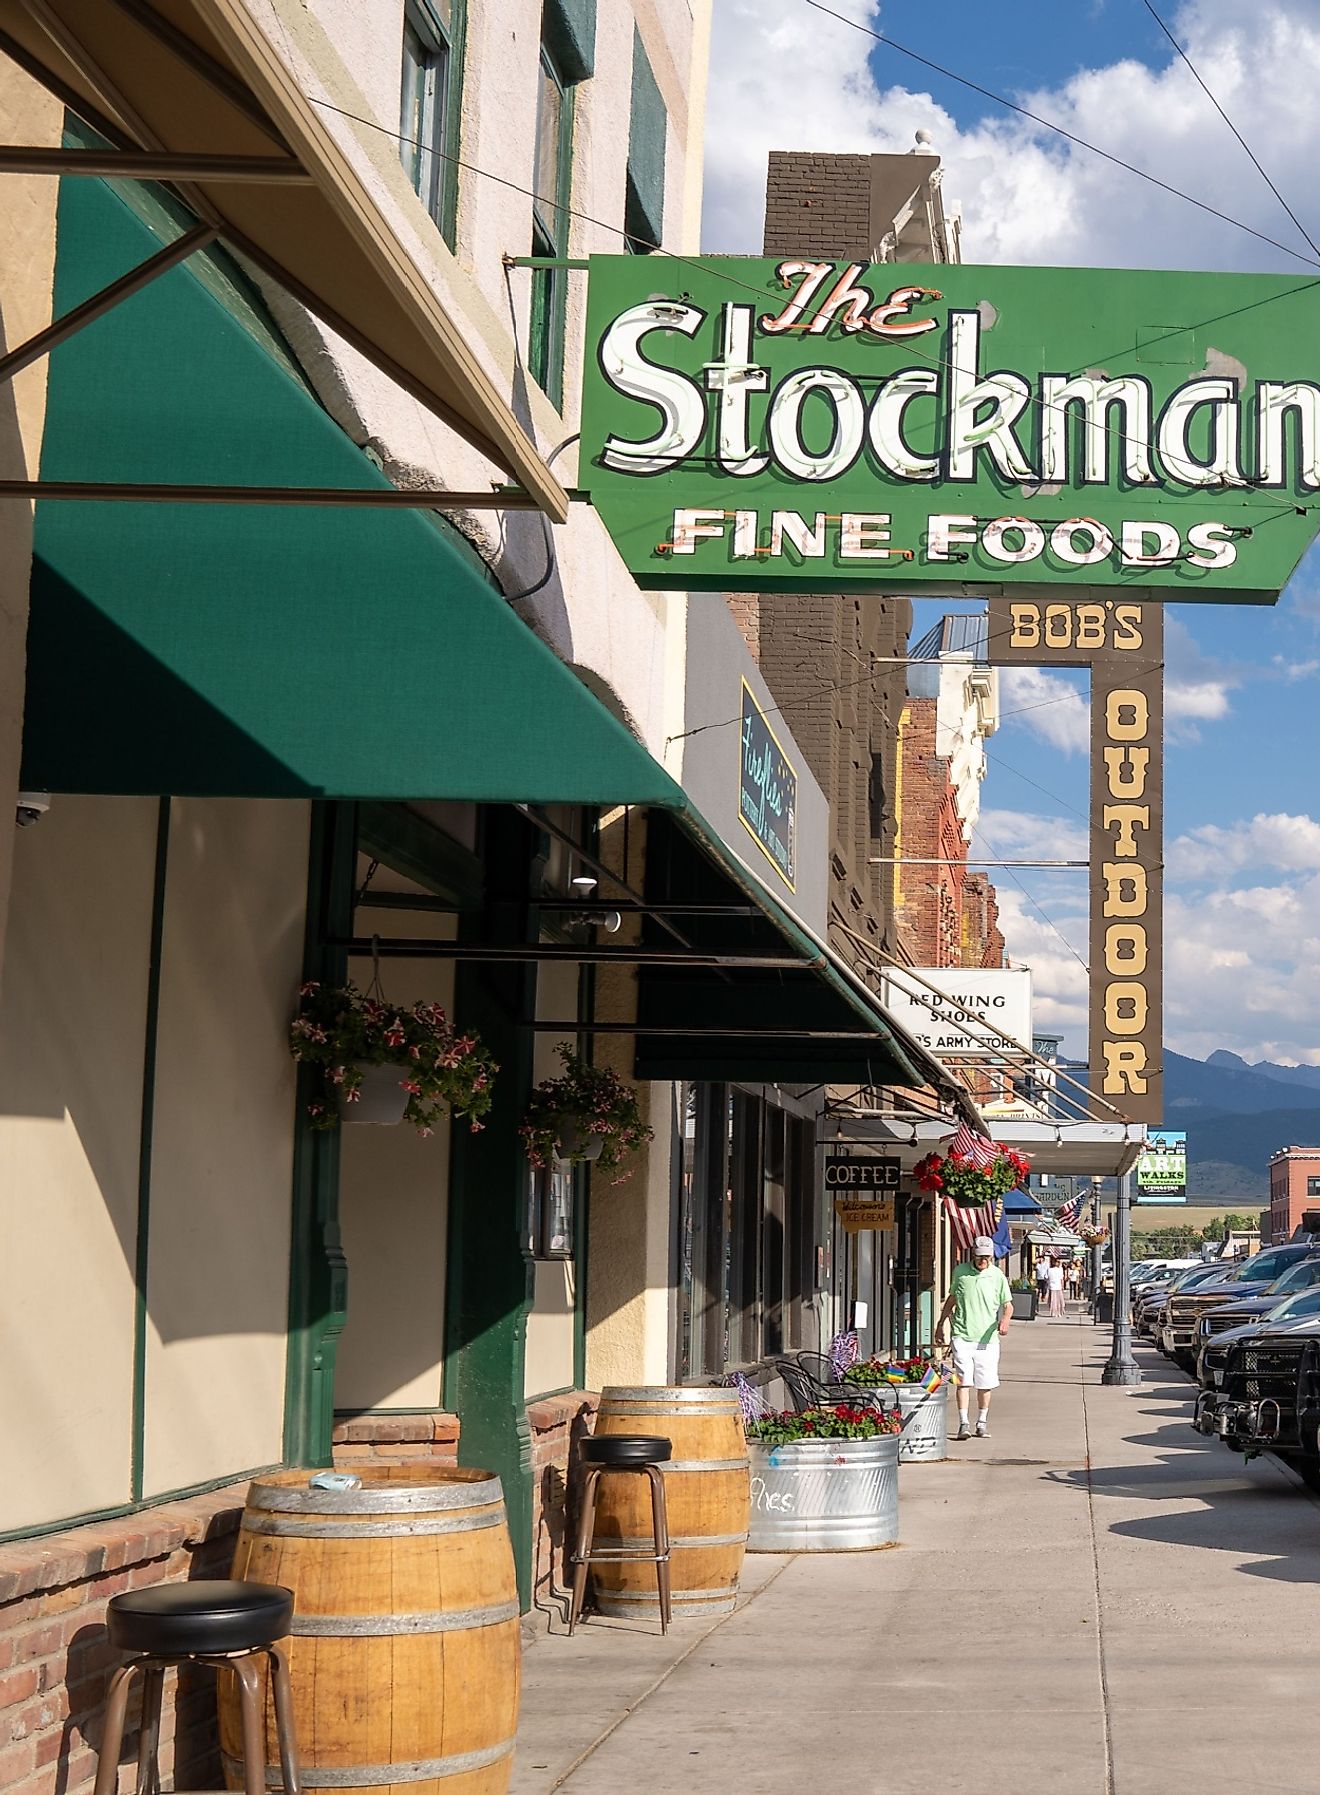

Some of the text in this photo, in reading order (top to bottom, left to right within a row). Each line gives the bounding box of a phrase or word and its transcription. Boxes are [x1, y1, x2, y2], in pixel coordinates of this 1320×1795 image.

[760, 260, 942, 337] The
[672, 507, 1238, 568] FINE FOODS
[1009, 600, 1143, 650] BOB'S
[1102, 688, 1150, 1096] OUTDOOR
[930, 1011, 986, 1022] SHOES
[954, 995, 1006, 1007] WING
[936, 1037, 973, 1048] ARMY
[980, 1037, 1017, 1049] STORE
[825, 1165, 899, 1185] COFFEE
